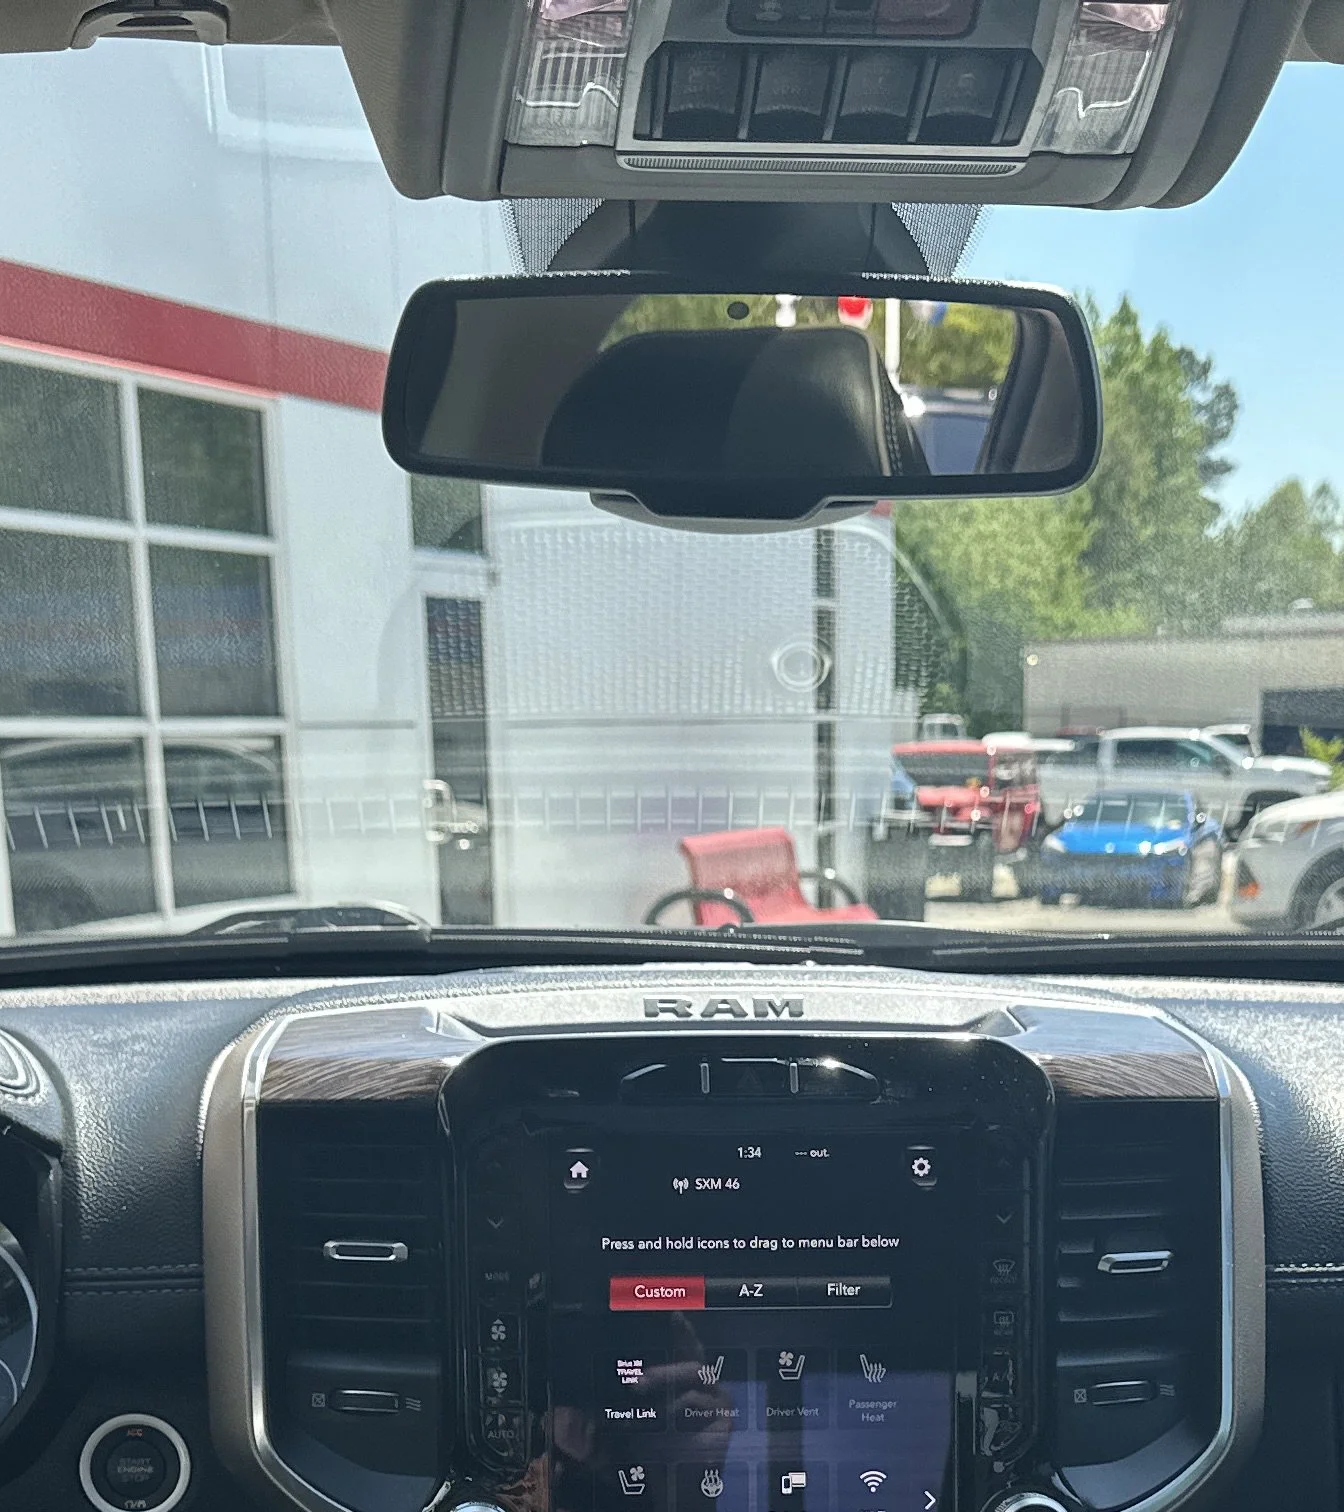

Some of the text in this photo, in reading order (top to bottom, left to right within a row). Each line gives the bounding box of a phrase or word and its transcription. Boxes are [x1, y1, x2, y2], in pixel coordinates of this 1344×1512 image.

[643, 997, 805, 1018] RAM
[737, 1146, 762, 1159] 1:34
[694, 1177, 741, 1191] SXM 46
[601, 1234, 900, 1251] Press and hold icons to drag to menu bar below
[634, 1284, 686, 1299] Custom
[738, 1283, 764, 1298] A-Z
[826, 1283, 861, 1297] Filter
[848, 1399, 898, 1410] Passenger
[604, 1407, 657, 1419] Travel Link
[684, 1407, 740, 1418] Driver Heat
[766, 1406, 820, 1417] Driver Vent
[861, 1412, 885, 1422] Heat
